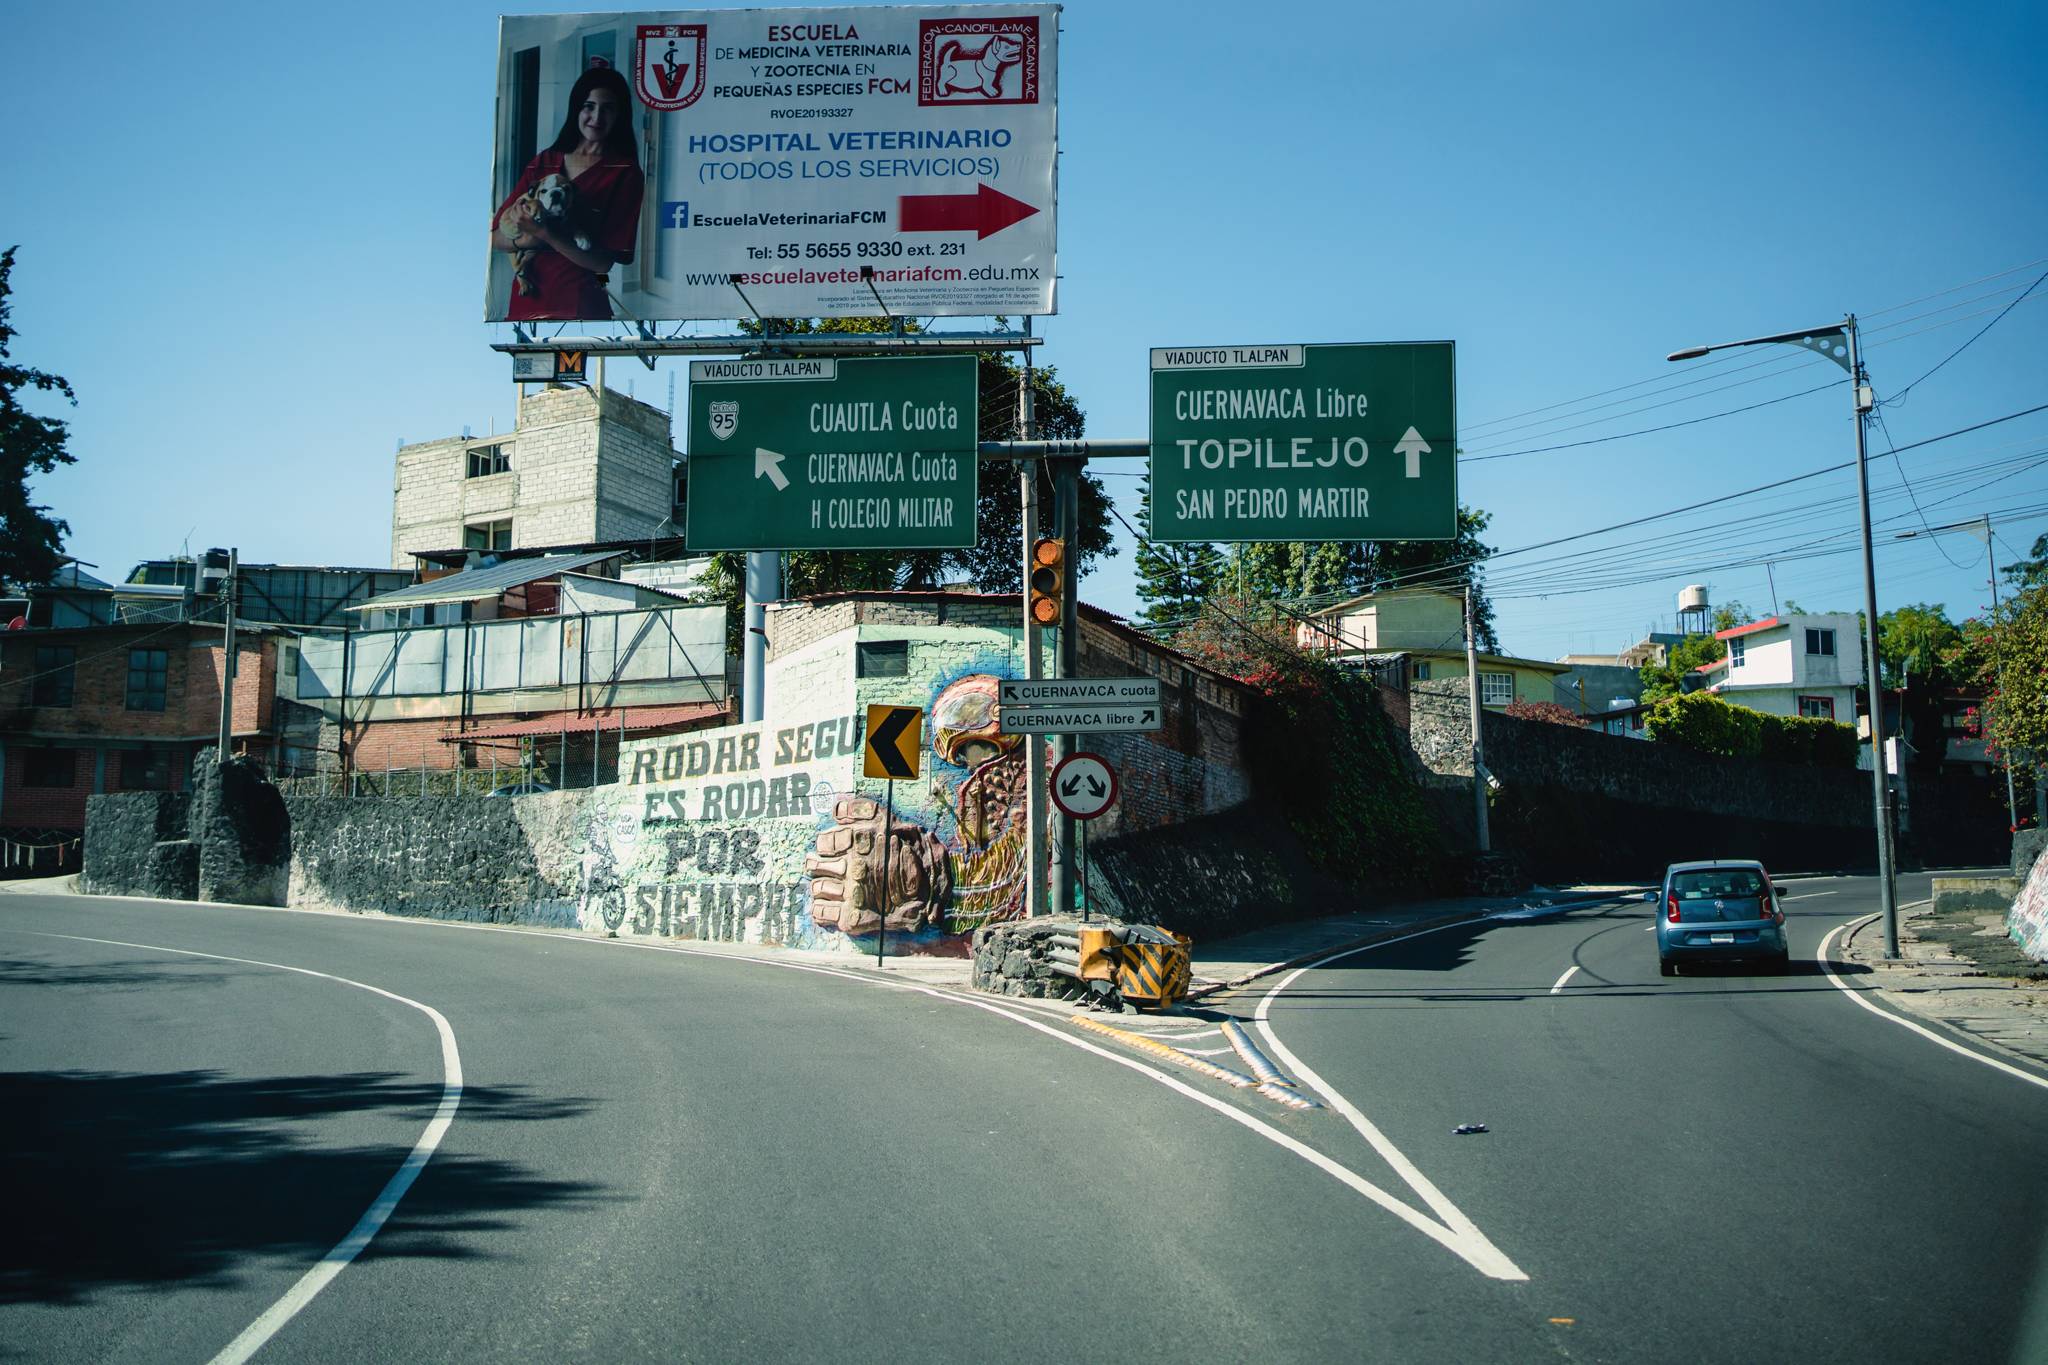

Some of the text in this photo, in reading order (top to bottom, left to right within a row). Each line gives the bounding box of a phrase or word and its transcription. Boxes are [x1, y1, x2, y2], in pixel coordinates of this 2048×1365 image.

[768, 24, 859, 41] ESCUELA
[715, 44, 912, 60] DE MEDICINA VETERINARIA
[922, 25, 940, 101] FEDERACION
[944, 23, 1010, 33] CANOFILA
[751, 63, 875, 77] Y ZOOTECNIA EN
[714, 78, 911, 98] PEQUEÑAS ESPECIES FCM
[770, 108, 854, 119] RVOE20193327
[689, 129, 1012, 153] HOSPITAL VETERINARIO
[699, 156, 1000, 185] (TODOS LOS SERVICIOS)
[693, 211, 887, 227] EscuelaVeterinariaFCM
[747, 241, 966, 260] Tel: 55 5655 9330 ext. 231
[686, 264, 1040, 286] wwwescuelaveternariafcm.edu.mx
[1165, 349, 1289, 365] VIADUCTO TLALPAN
[704, 361, 821, 377] VIADUCTO TLALPAN
[1175, 387, 1368, 421] CUERNAVACA Libre
[713, 413, 735, 429] 95
[810, 400, 958, 433] CUAUTLA Cuota
[1175, 436, 1369, 470] TOPILEJO
[808, 451, 957, 484] CUERNAVACA Cuota
[812, 497, 953, 529] H COLEGIO MILITAR
[1176, 487, 1369, 520] SAN PEDRO MARTIR
[1022, 685, 1156, 699] CUERNAVACA cuota
[1007, 713, 1135, 727] CUERNAVACA libre
[628, 731, 760, 785] RODAR
[643, 789, 686, 824] ES
[700, 772, 812, 821] RODAR
[664, 829, 766, 876] POR
